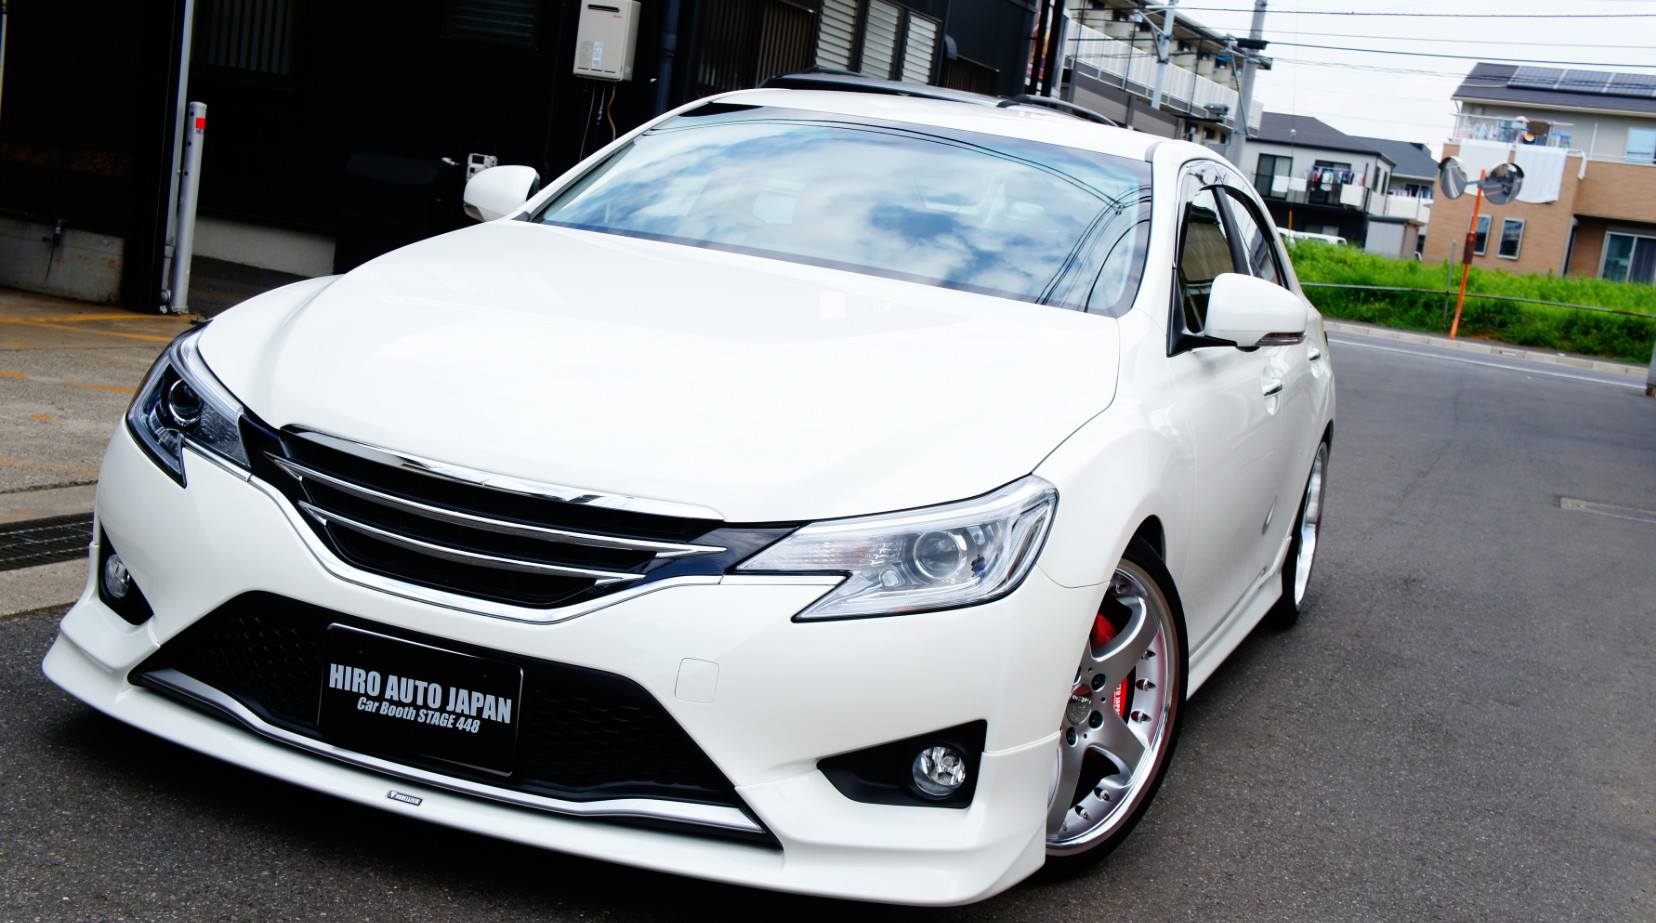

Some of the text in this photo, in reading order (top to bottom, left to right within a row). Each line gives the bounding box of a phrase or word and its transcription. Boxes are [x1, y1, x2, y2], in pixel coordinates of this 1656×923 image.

[329, 663, 512, 724] HIRO AUTO JAPAN
[357, 697, 480, 733] Car Booth STAGE 448
